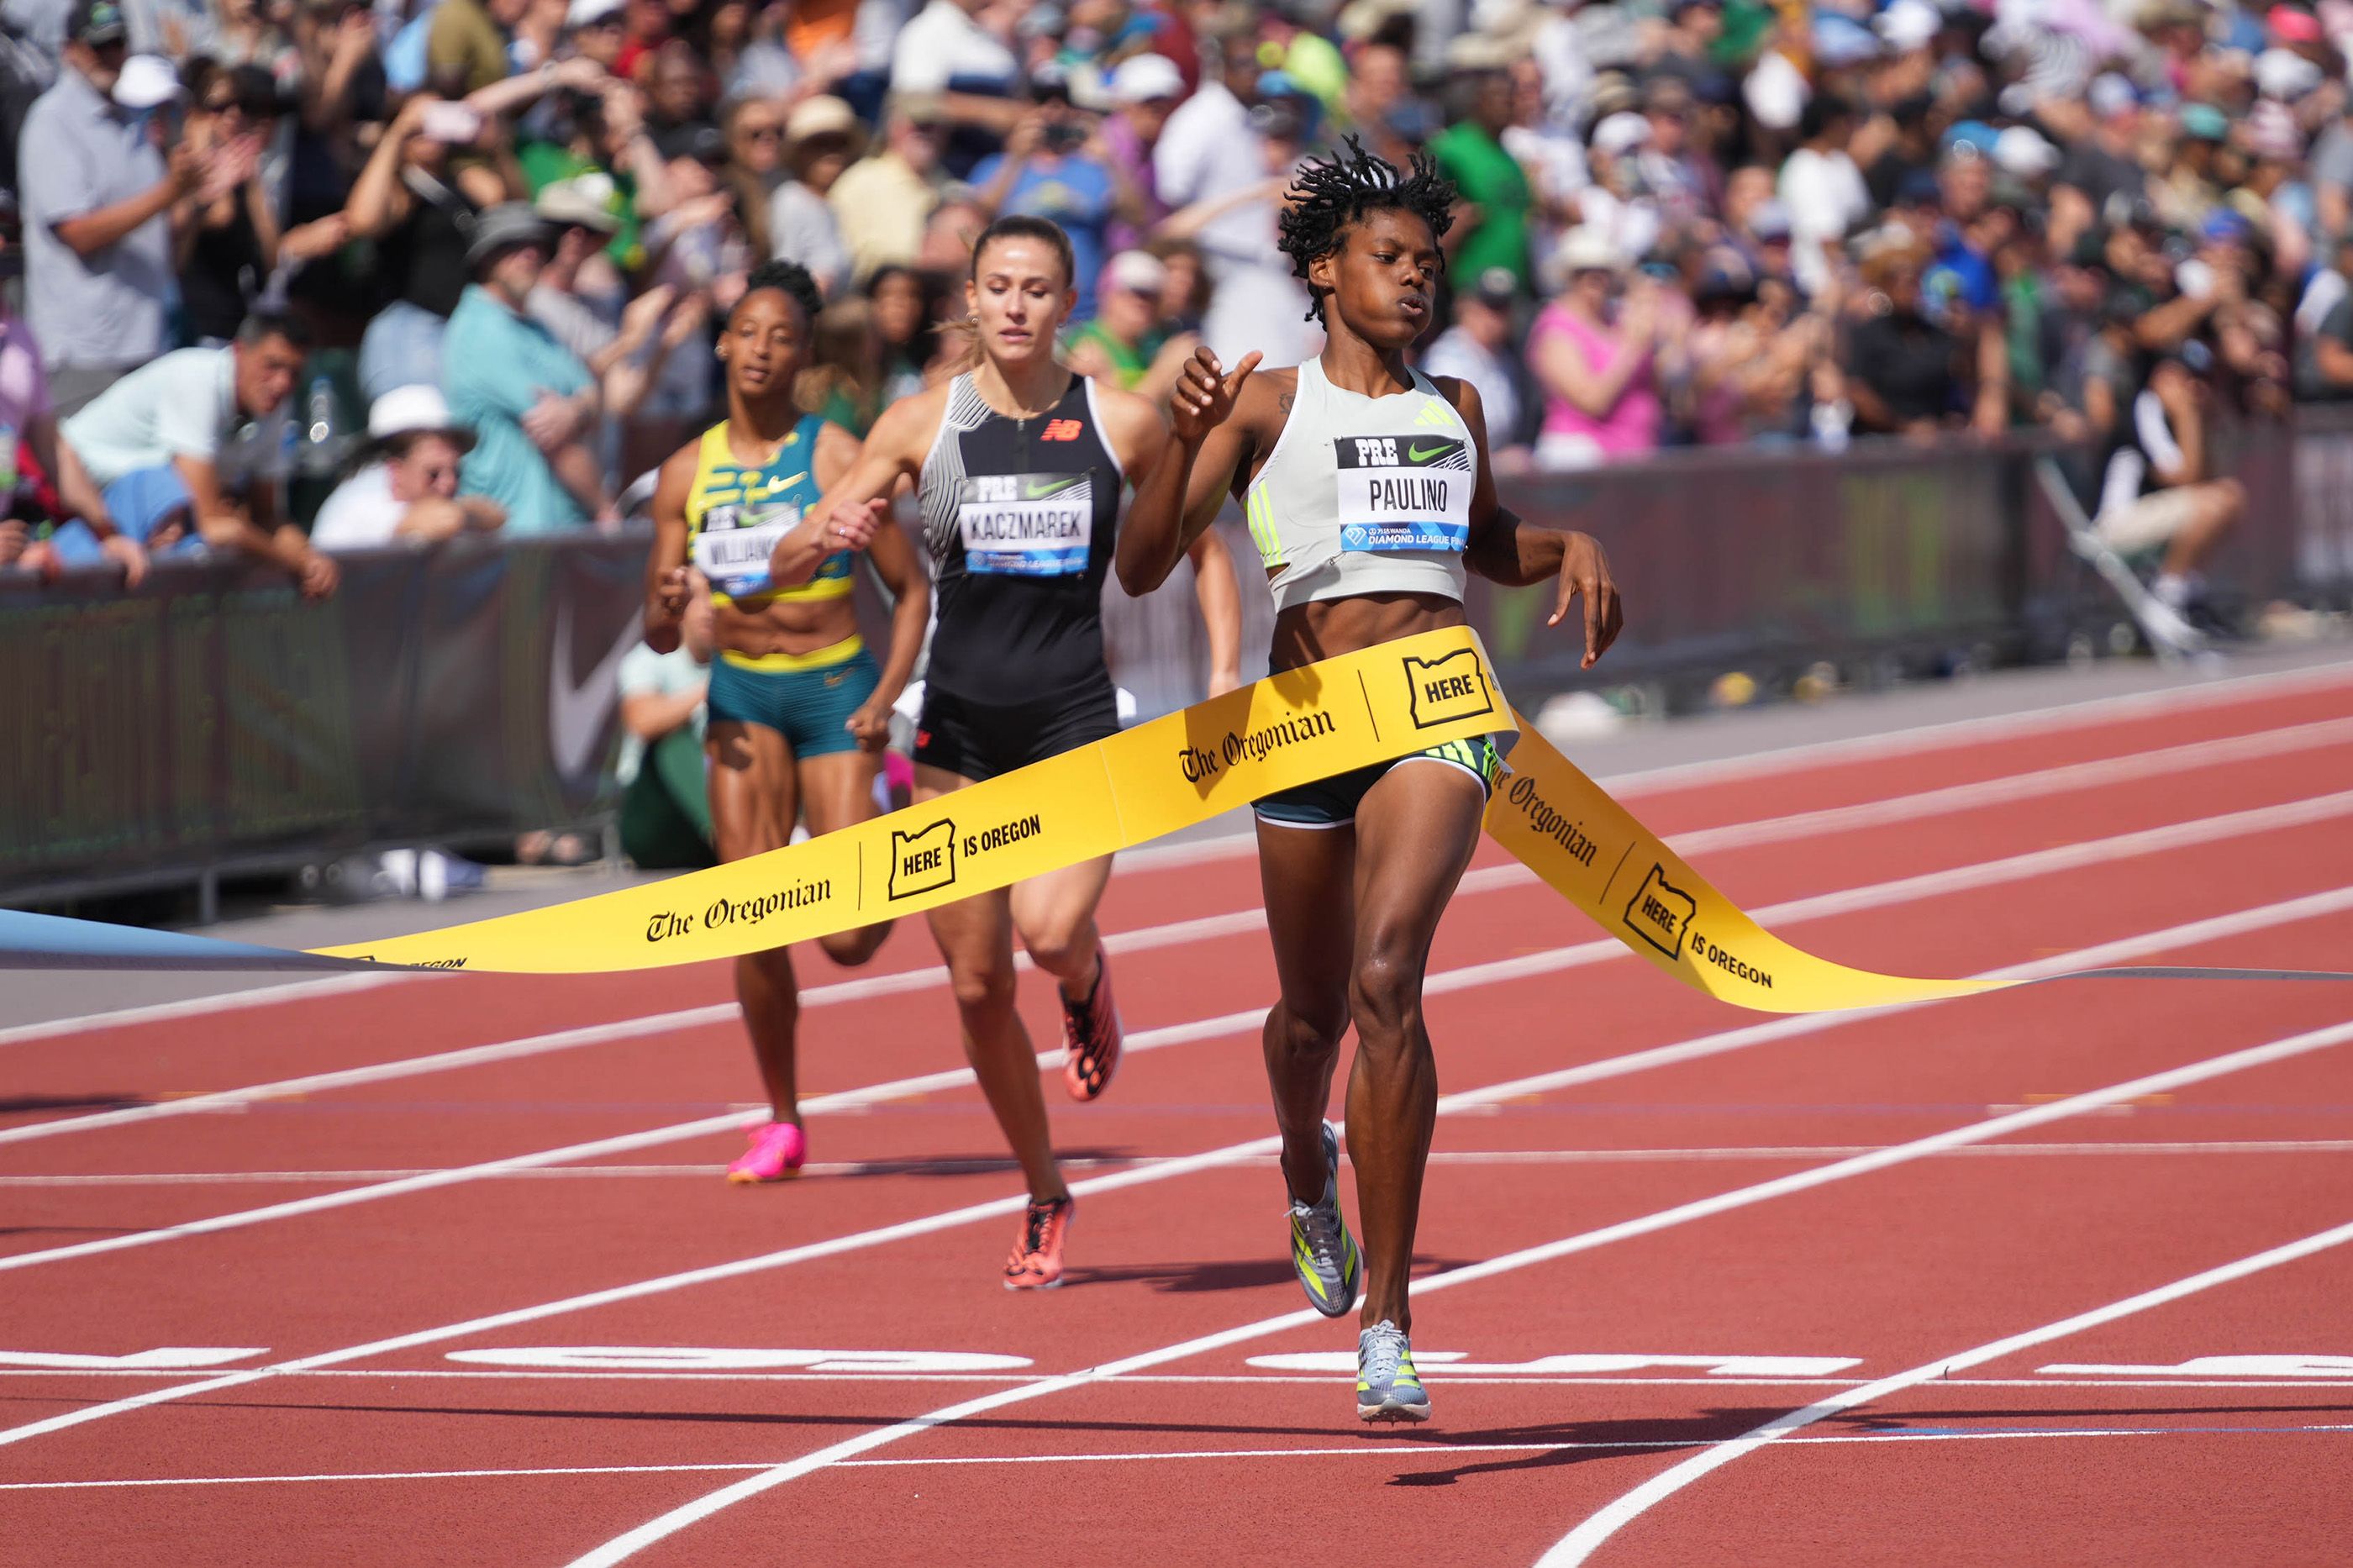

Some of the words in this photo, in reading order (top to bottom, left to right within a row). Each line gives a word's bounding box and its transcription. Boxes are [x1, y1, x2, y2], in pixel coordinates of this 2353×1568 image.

[1355, 438, 1399, 466] PRE
[1369, 478, 1448, 513] PAULINO
[970, 510, 1082, 540] KACZMAREK
[1368, 534, 1414, 545] DIAMOND
[1416, 535, 1450, 545] LEAGUE
[1450, 536, 1466, 546] FIN
[1424, 674, 1475, 704] HERE
[1178, 745, 1219, 783] The
[1222, 709, 1336, 763] Oregonian
[903, 846, 942, 876] HERE
[963, 836, 978, 858] IS
[981, 813, 1041, 850] OREGON
[1508, 776, 1598, 867] Oregonian
[646, 912, 694, 943] The
[703, 878, 832, 929] Oregonian
[1641, 894, 1677, 934] HERE
[1691, 932, 1706, 955] IS
[1708, 944, 1773, 988] OREGON
